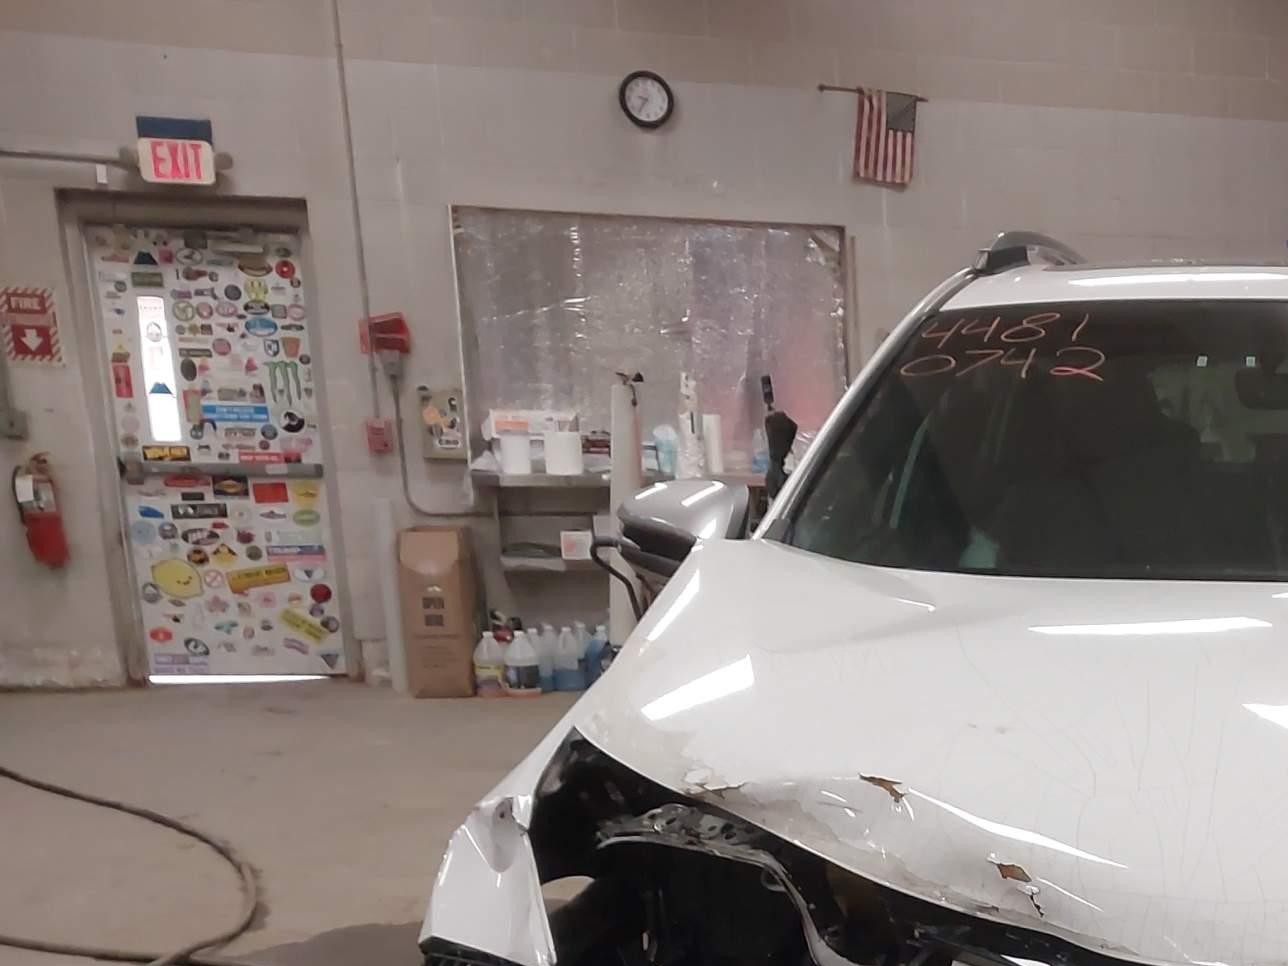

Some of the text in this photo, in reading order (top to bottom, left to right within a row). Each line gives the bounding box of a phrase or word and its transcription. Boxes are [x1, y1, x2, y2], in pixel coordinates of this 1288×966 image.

[150, 140, 204, 181] EXIT
[9, 296, 42, 311] FIRE
[921, 312, 1089, 349] 4481
[900, 347, 1106, 381] 0742
